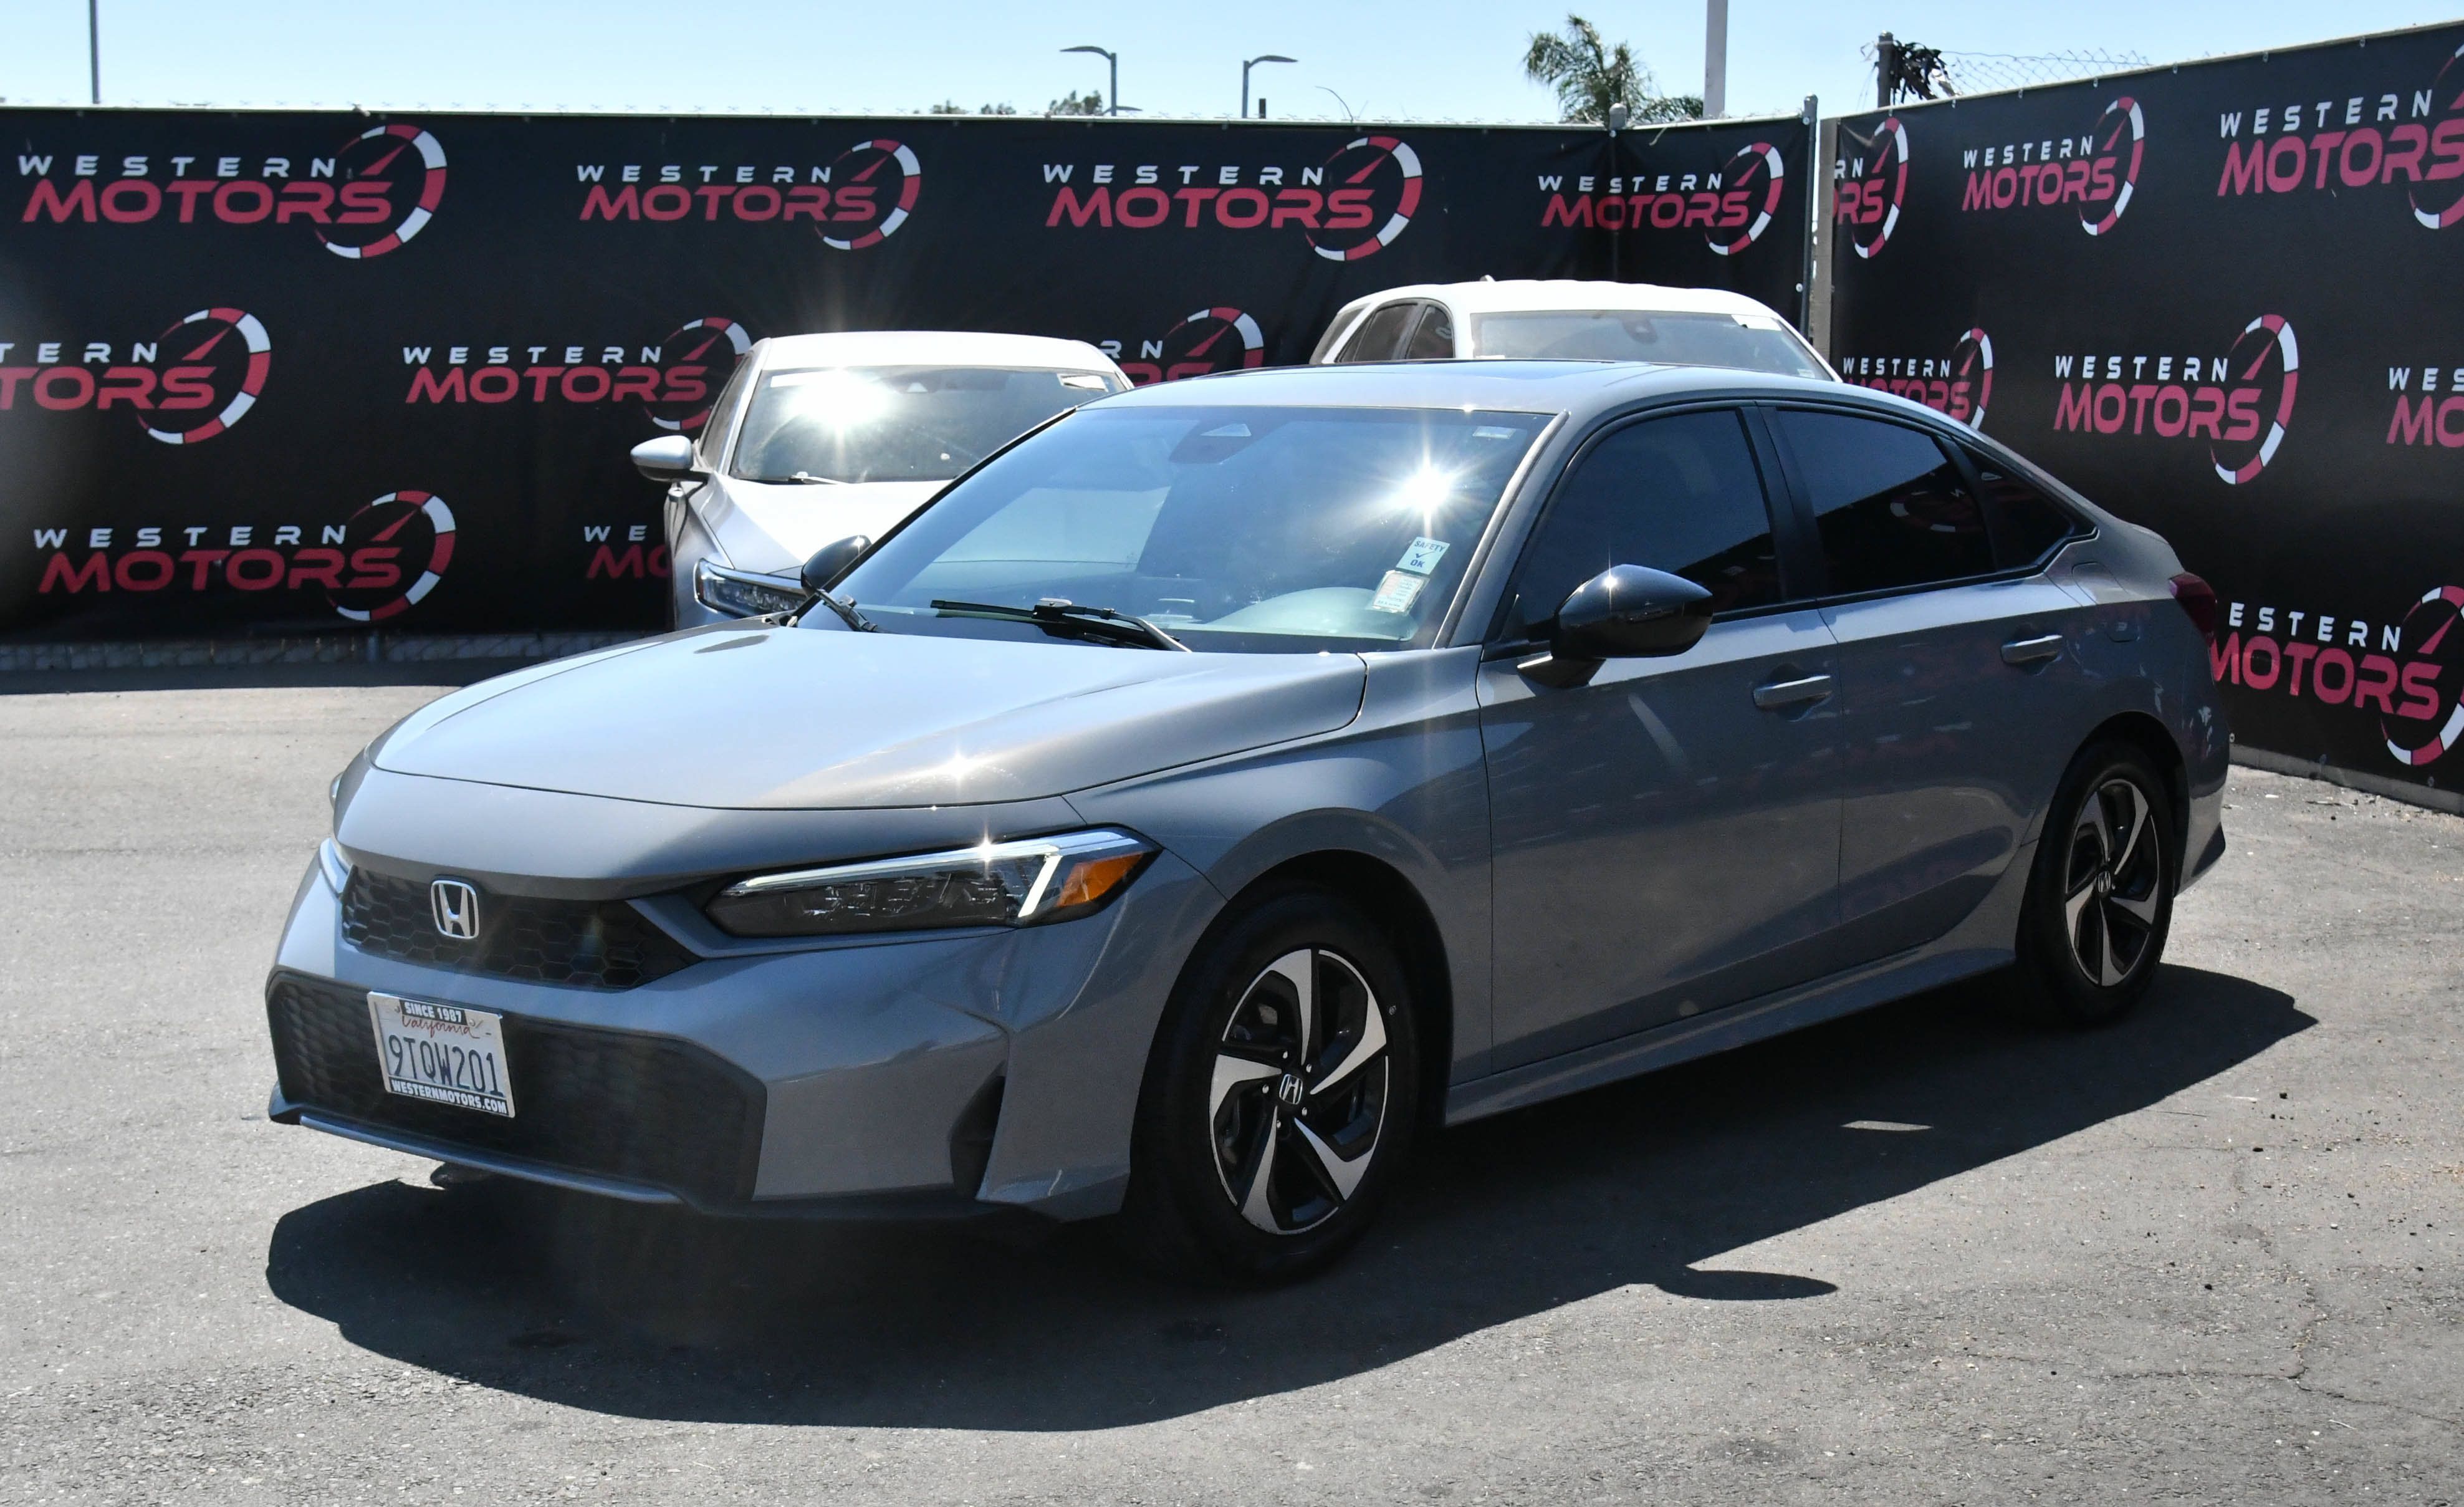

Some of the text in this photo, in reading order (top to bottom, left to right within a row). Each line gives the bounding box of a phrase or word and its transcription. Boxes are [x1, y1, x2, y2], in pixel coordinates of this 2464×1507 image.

[2220, 89, 2432, 138] WESTERN
[19, 155, 335, 178] WESTERN
[1964, 135, 2093, 169] WESTERN
[2218, 118, 2464, 196] MOTORS
[577, 165, 831, 183] WESTERN
[1043, 164, 1323, 186] WESTERN
[1538, 173, 1722, 193] WESTERN
[1963, 156, 2117, 211] MOTORS
[22, 179, 392, 224] MOTORS
[580, 185, 876, 221] MOTORS
[1046, 186, 1374, 229] MOTORS
[1541, 190, 1752, 230] MOTORS
[0, 342, 158, 364] TERN
[403, 346, 661, 364] WESTERN
[1843, 357, 1950, 378] WESTERN
[2055, 355, 2228, 382] WESTERN
[0, 365, 216, 410] TORS
[406, 365, 707, 403] MOTORS
[2054, 382, 2263, 441] MOTORS
[34, 525, 347, 548] WESTERN
[1414, 541, 1445, 552] SAFETY
[38, 546, 402, 594] MOTORS
[1410, 559, 1425, 568] OK
[2229, 602, 2401, 652] ESTERN
[405, 1001, 462, 1023] SINCE 1987
[388, 1034, 504, 1097] 9TQW201
[391, 1079, 507, 1114] WESTERNMOTORS.COM
